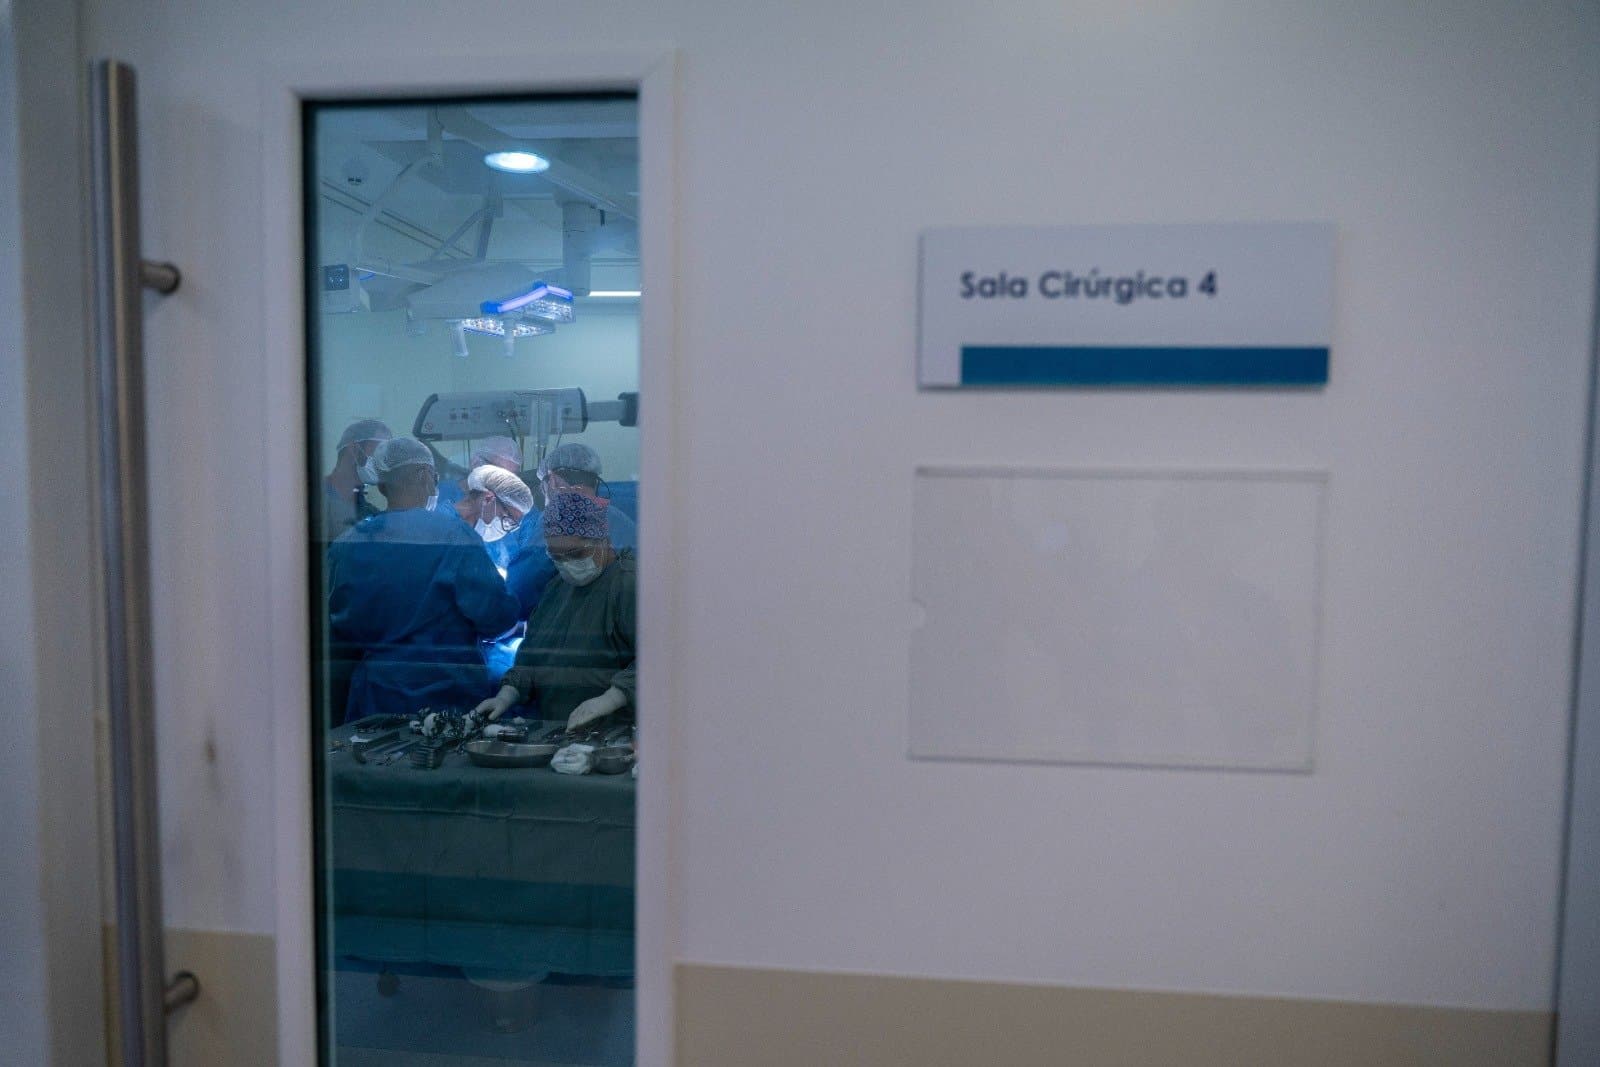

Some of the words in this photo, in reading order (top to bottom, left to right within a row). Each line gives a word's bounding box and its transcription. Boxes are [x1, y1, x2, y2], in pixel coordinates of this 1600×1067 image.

[960, 270, 1028, 298] Sala
[1039, 267, 1188, 305] Cirúrgica
[1198, 270, 1218, 298] 4
